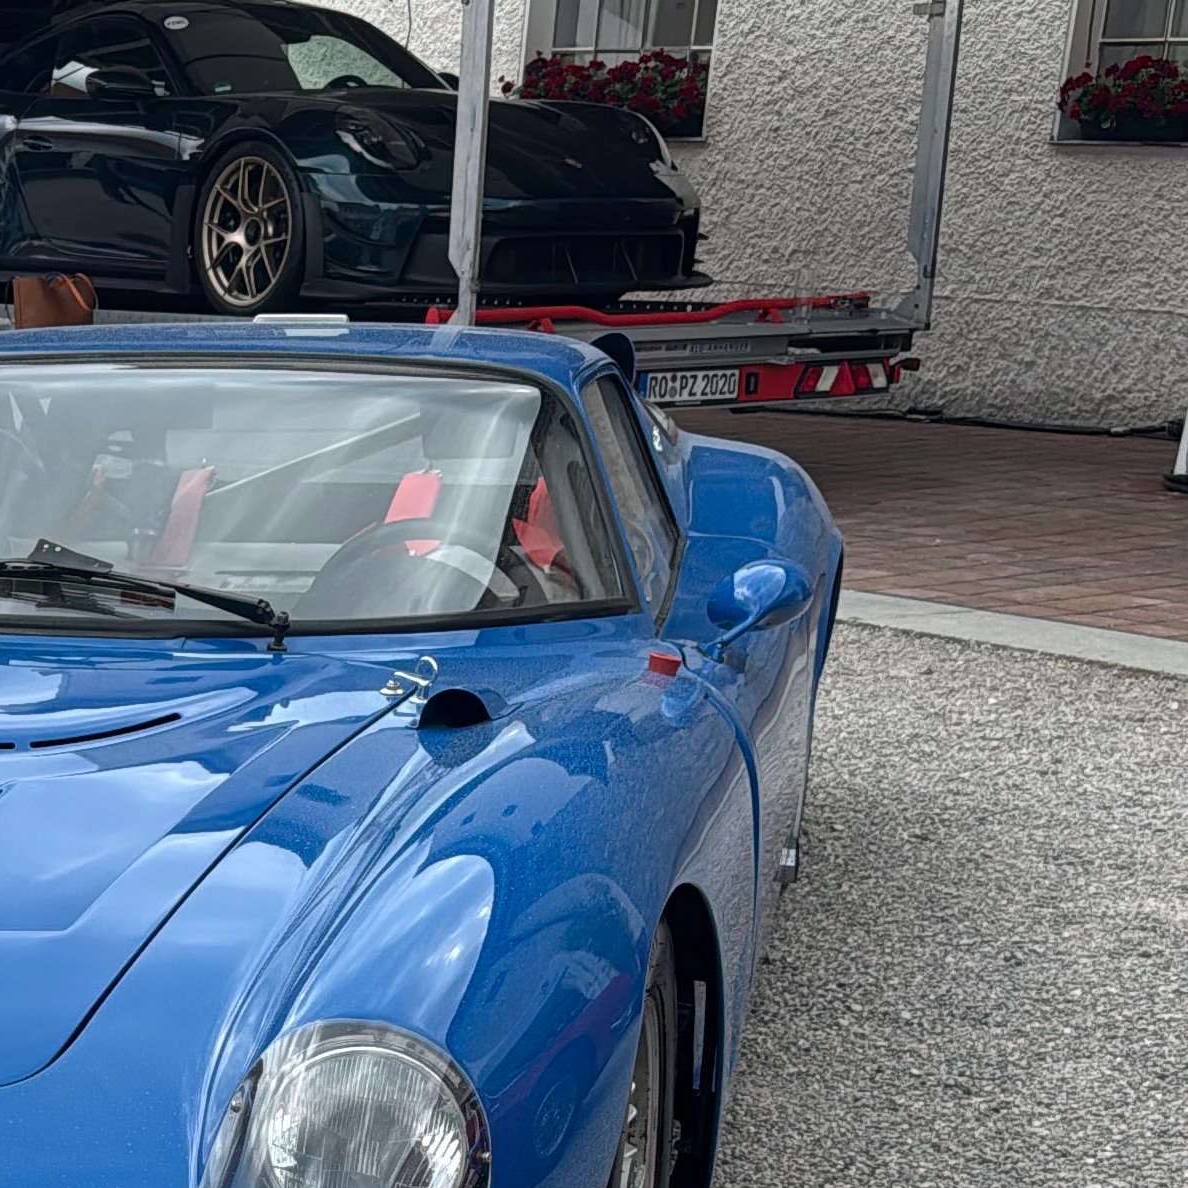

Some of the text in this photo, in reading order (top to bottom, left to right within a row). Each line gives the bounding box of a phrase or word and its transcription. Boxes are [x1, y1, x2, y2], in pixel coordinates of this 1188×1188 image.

[648, 372, 737, 398] RO PZ 2020
